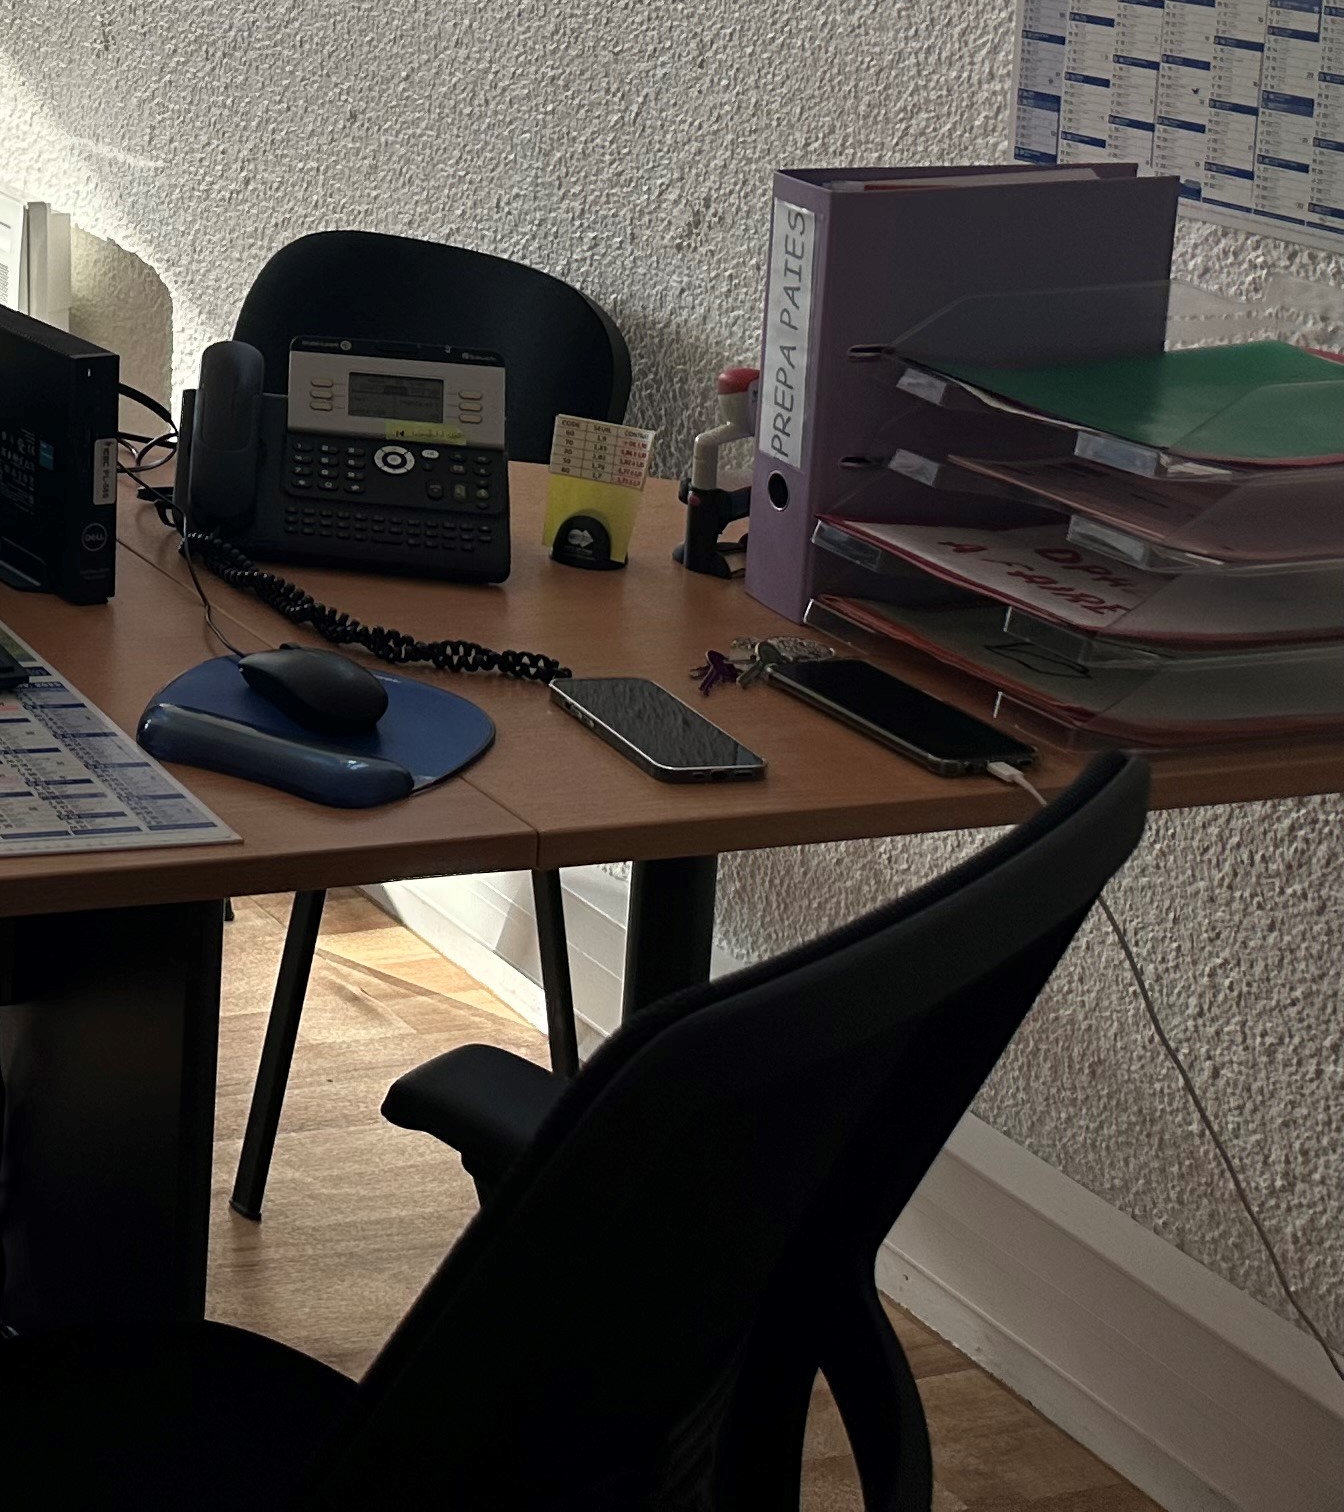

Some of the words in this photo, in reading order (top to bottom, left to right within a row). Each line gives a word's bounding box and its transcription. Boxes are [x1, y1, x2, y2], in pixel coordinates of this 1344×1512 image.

[778, 211, 807, 332] PAIES
[769, 345, 804, 457] PREPA
[85, 533, 104, 541] DELL
